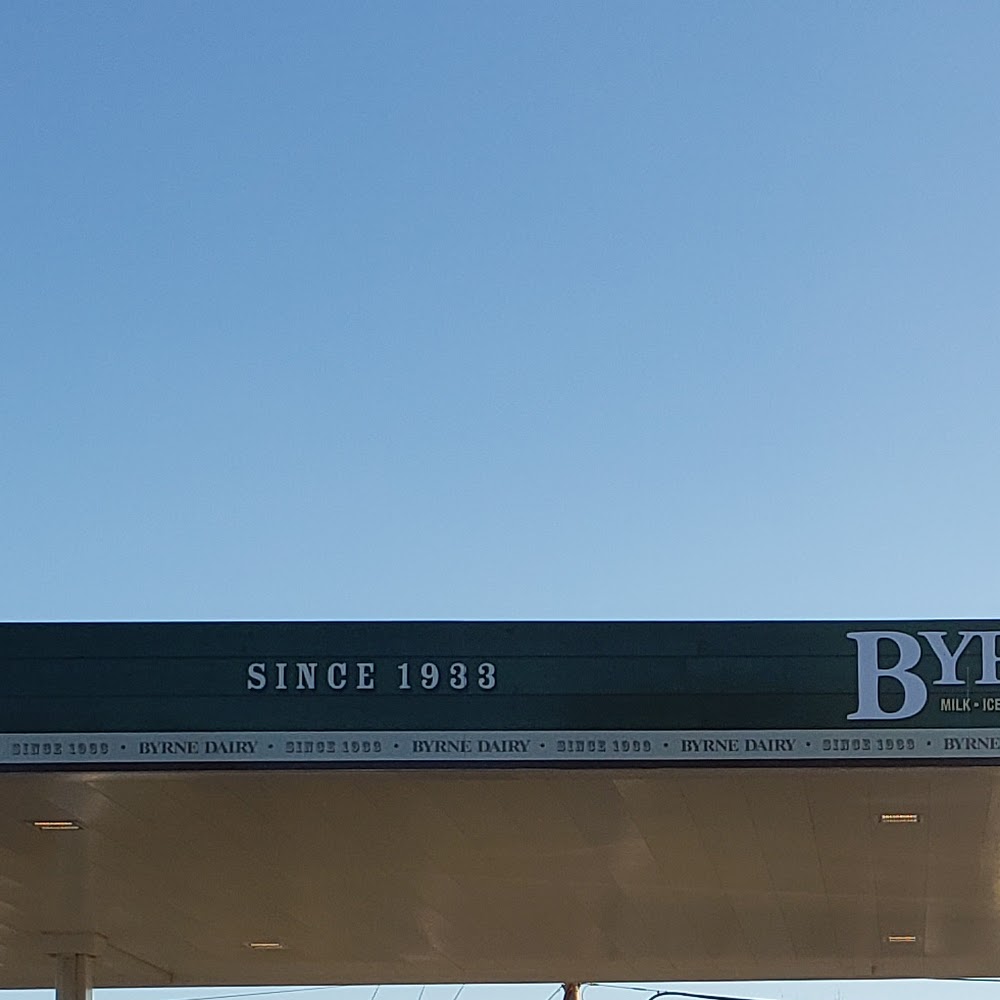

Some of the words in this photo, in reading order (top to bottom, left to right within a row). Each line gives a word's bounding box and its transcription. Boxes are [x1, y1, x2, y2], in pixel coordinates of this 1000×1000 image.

[247, 662, 376, 690] SINCE
[397, 661, 497, 690] 1933
[940, 697, 971, 712] MILK
[139, 741, 198, 754] BYRNE
[204, 740, 258, 754] DAIRY
[412, 740, 471, 753] BYRNE
[477, 739, 531, 752] DAIRY
[681, 739, 739, 751] BYRNE
[744, 738, 797, 751] DAIRY
[944, 737, 1000, 750] BYRNE
